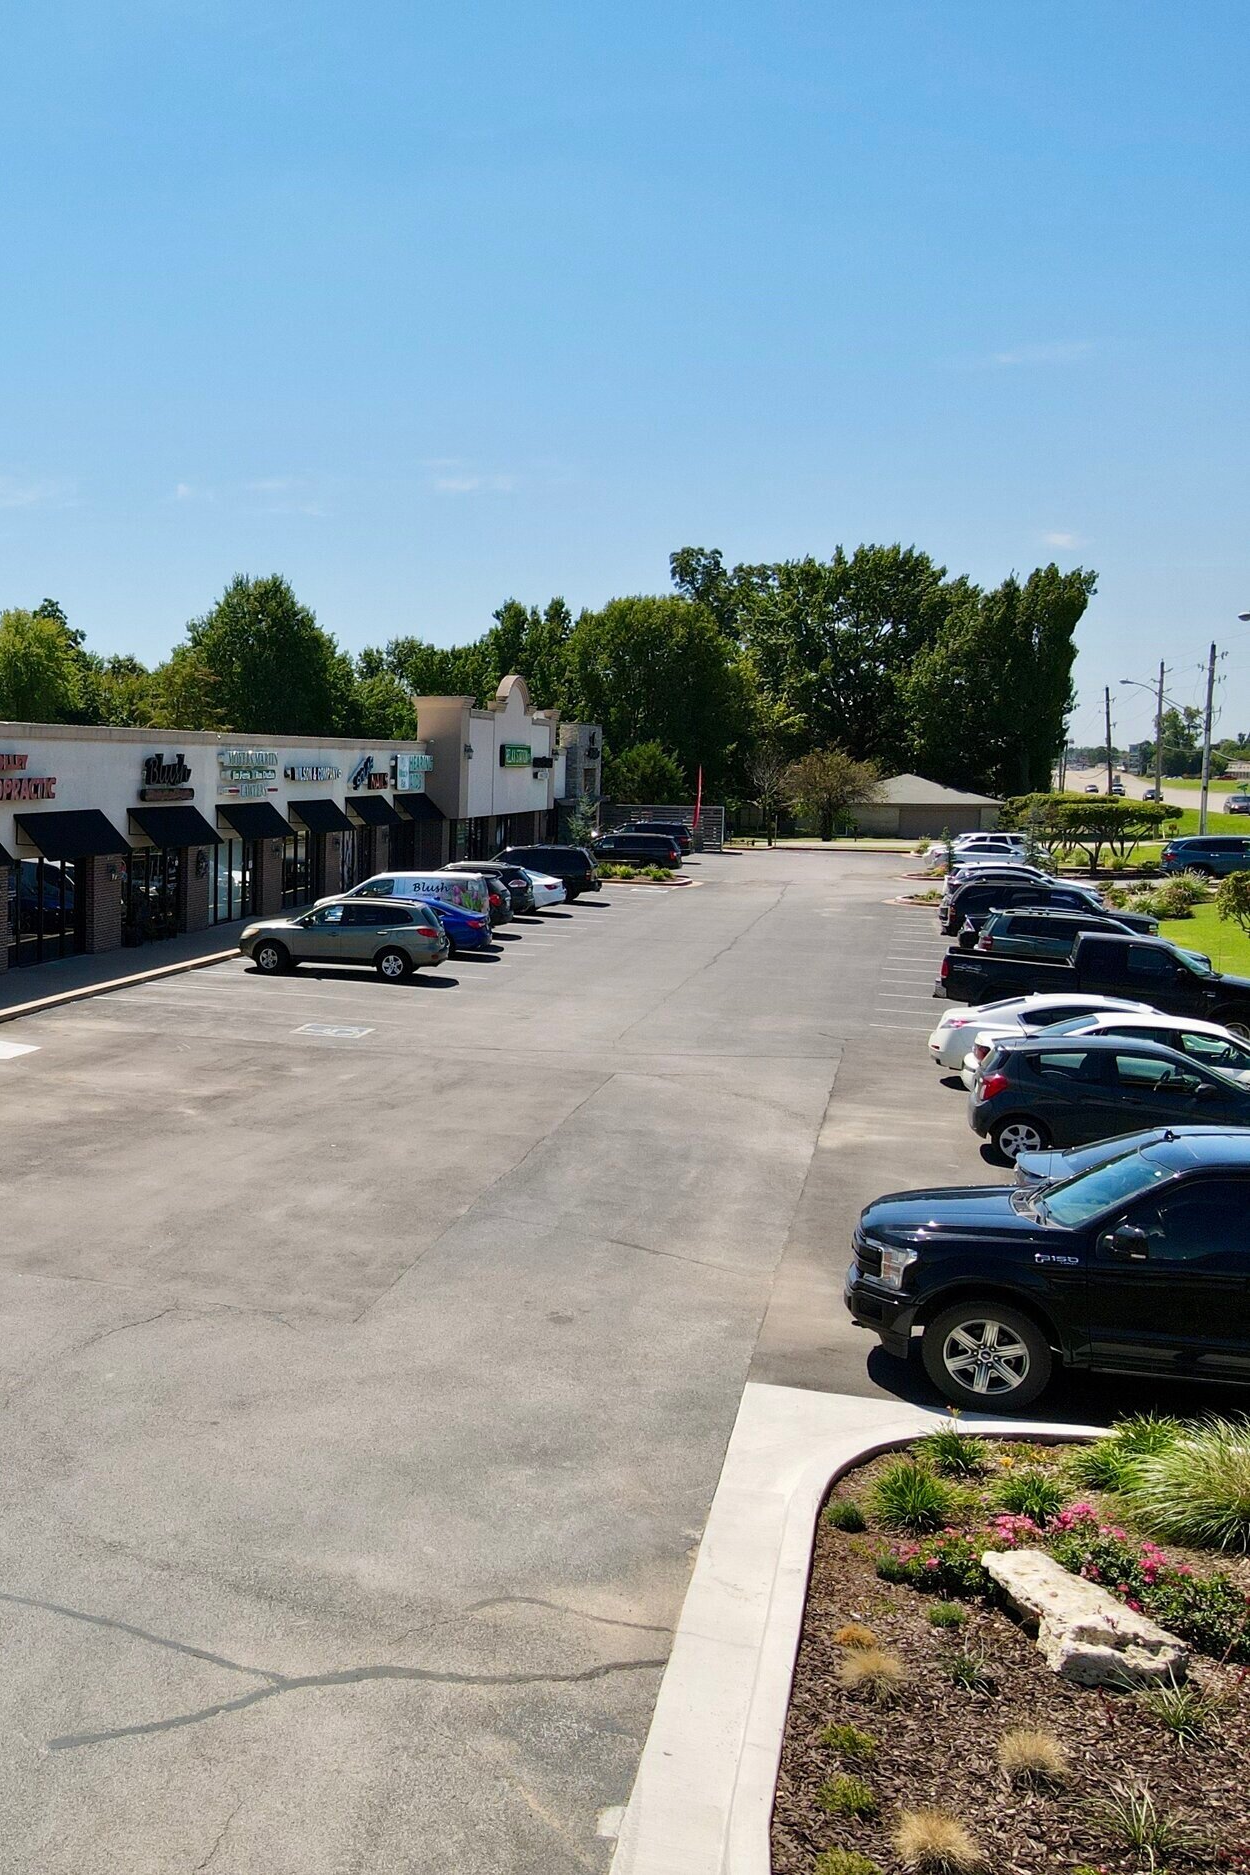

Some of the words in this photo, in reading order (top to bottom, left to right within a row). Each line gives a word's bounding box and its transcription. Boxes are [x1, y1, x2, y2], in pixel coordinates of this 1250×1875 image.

[145, 753, 191, 786] Blush
[369, 773, 387, 789] NAILS
[413, 882, 450, 893] Blush
